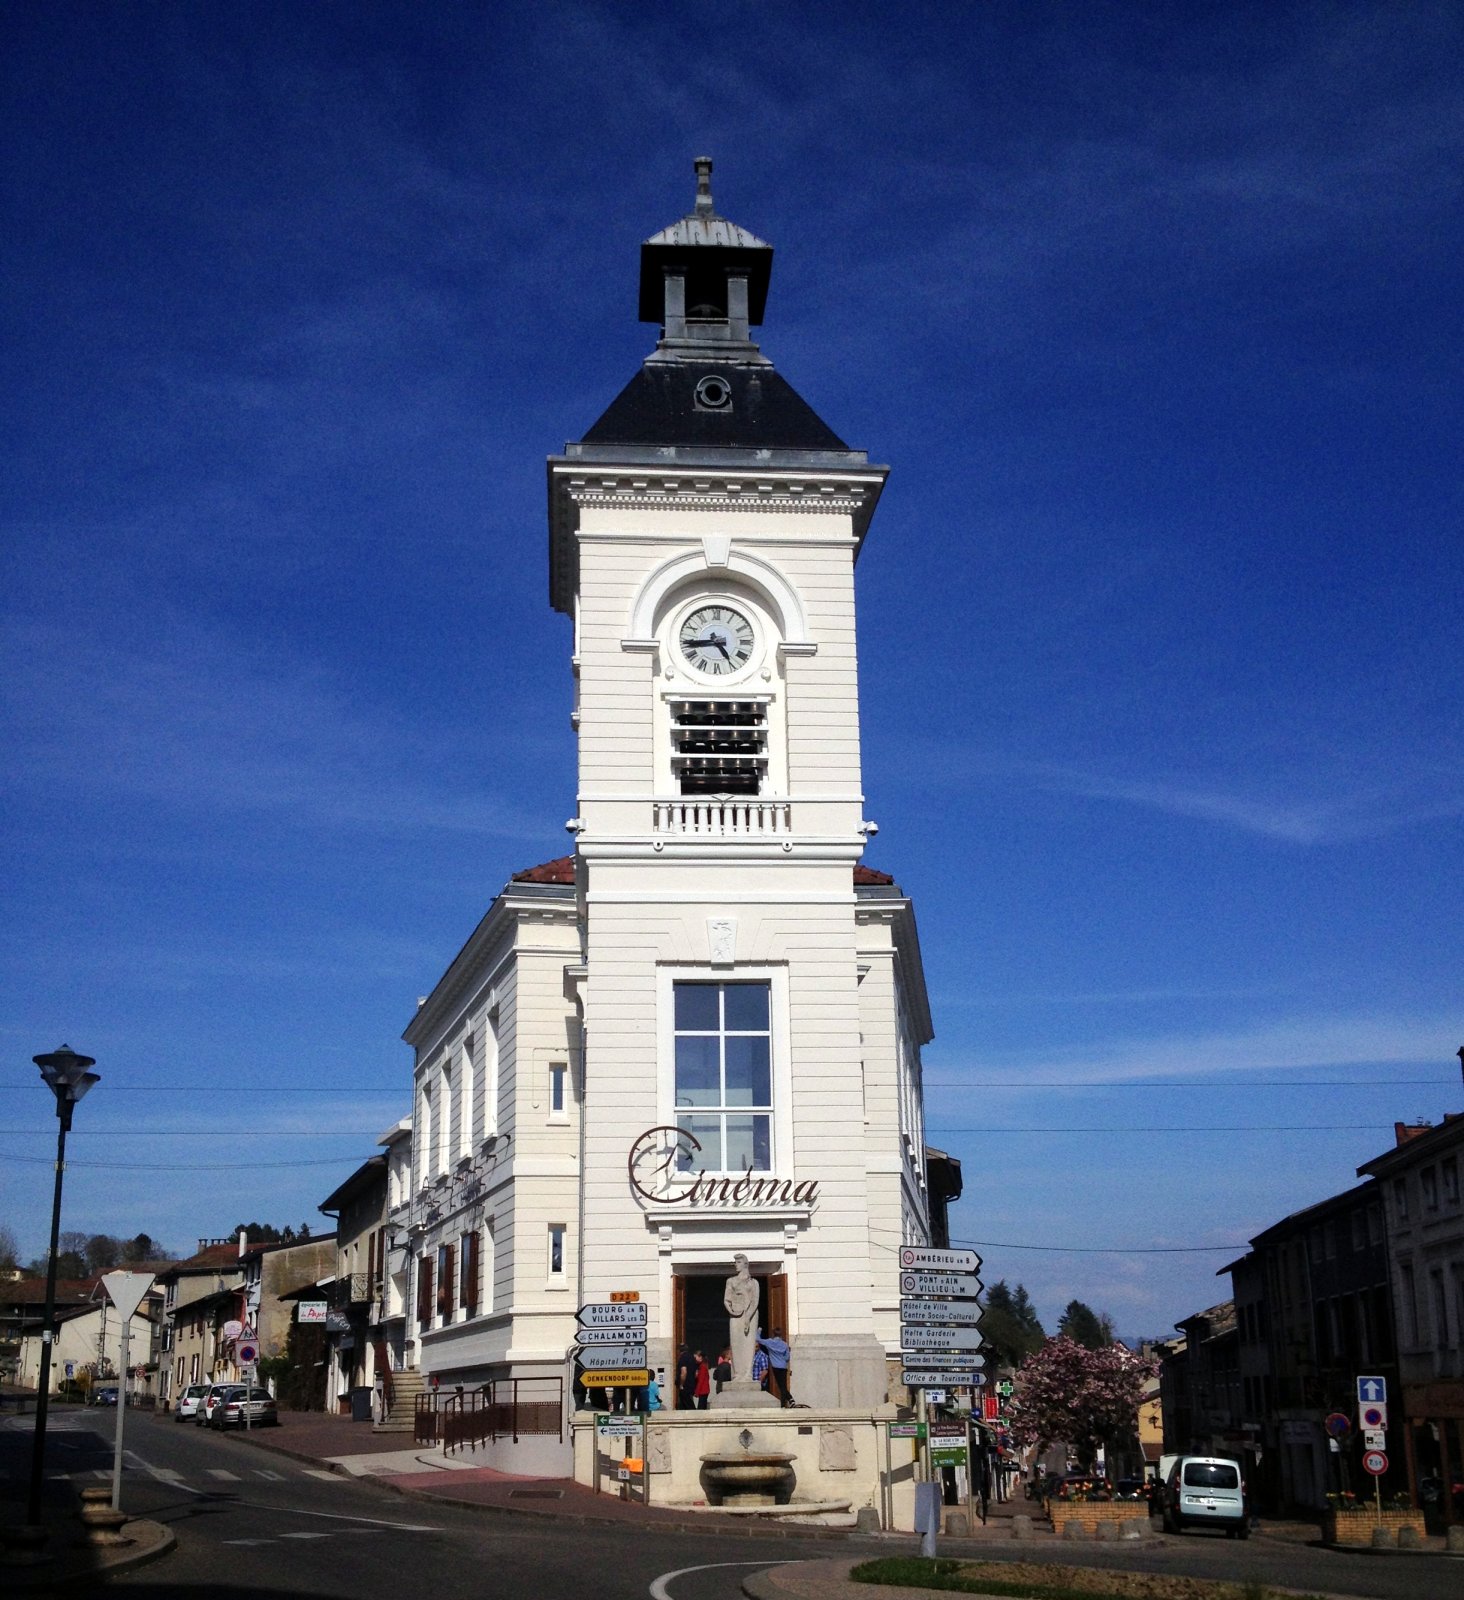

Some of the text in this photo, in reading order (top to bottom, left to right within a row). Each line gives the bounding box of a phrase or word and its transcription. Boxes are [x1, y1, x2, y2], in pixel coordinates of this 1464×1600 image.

[628, 1126, 818, 1203] Cinéma
[916, 1254, 954, 1264] AMBÉRIEU
[918, 1276, 938, 1284] PONT
[592, 1306, 623, 1314] BOURG
[592, 1314, 625, 1323] VILLARS
[588, 1331, 643, 1340] CHALAMONT
[589, 1358, 619, 1366] Hôpital
[587, 1374, 630, 1382] DENKENDORF
